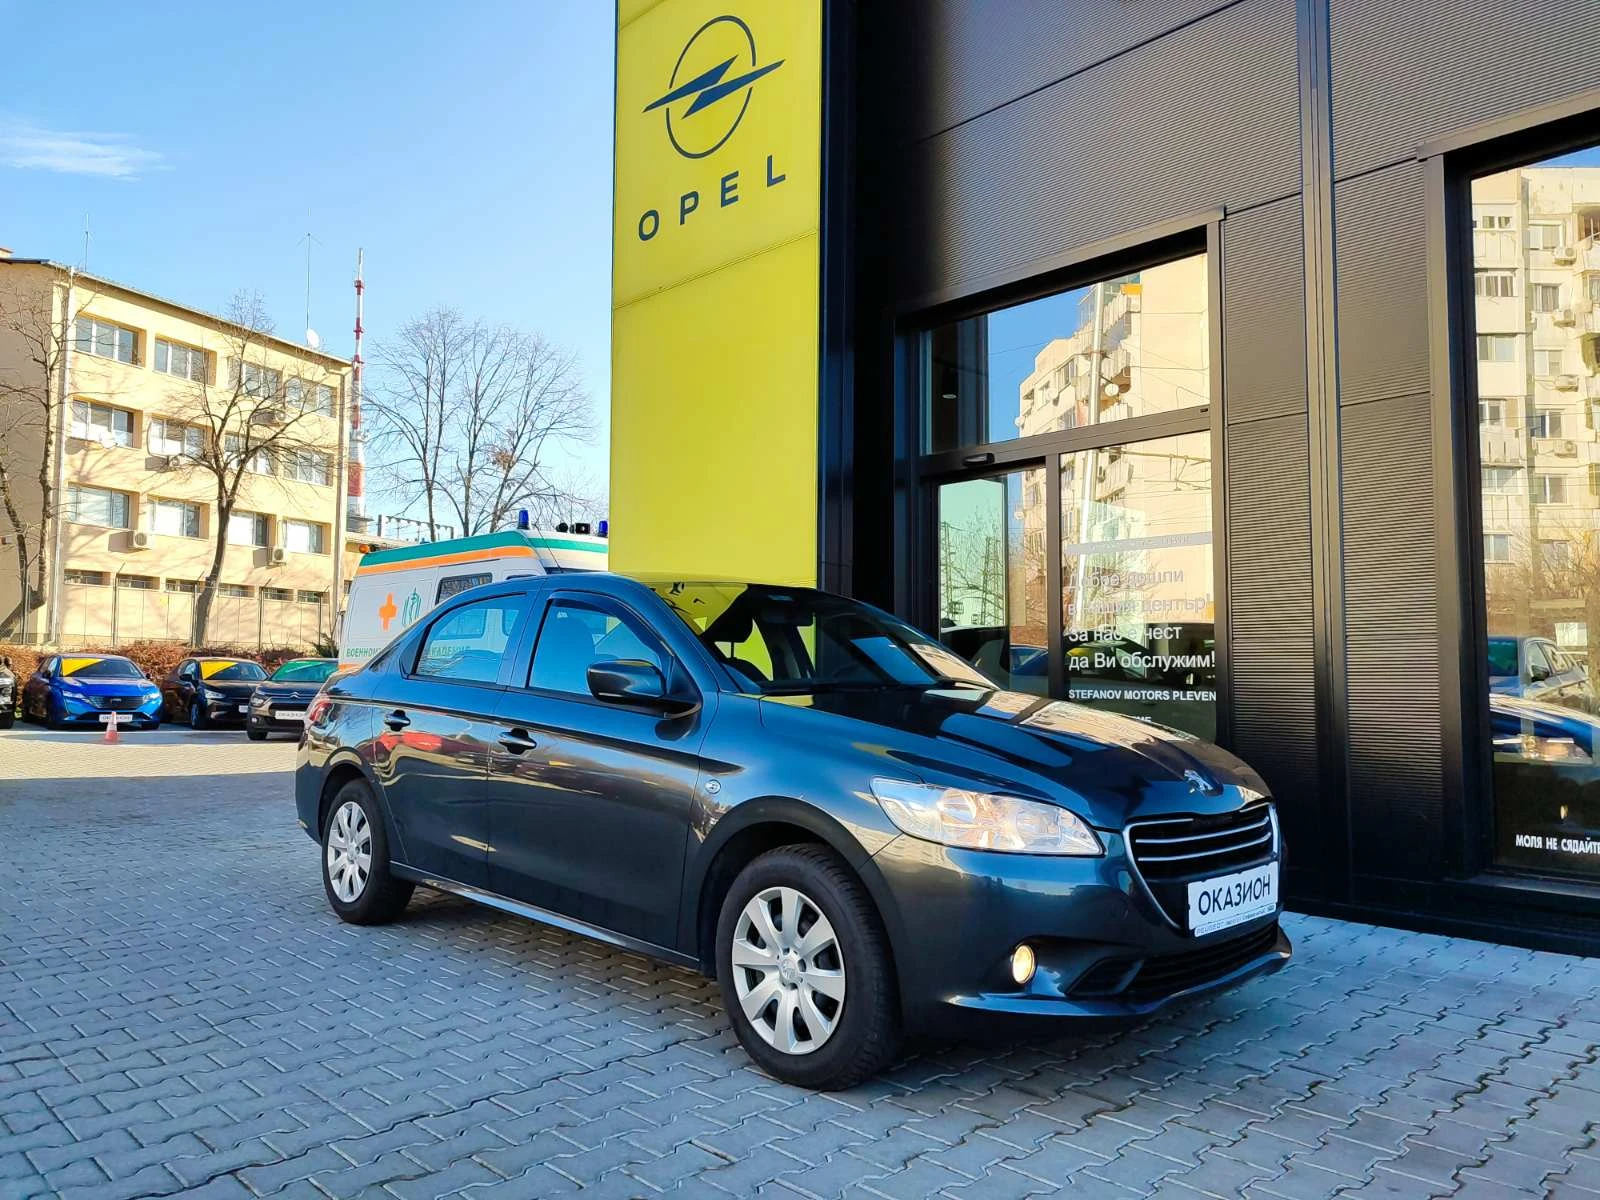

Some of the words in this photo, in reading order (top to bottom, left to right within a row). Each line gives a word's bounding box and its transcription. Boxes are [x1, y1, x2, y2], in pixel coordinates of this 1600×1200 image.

[638, 154, 786, 241] OPEL
[1068, 655, 1089, 671] да
[1094, 652, 1116, 668] Ви
[1121, 651, 1216, 672] обслужим!
[1068, 689, 1122, 700] STEFANOV
[1124, 690, 1170, 701] MOTORS
[1172, 690, 1216, 701] PLEVEN
[1515, 834, 1542, 848] МОЛЯ
[1546, 837, 1558, 850] НЕ
[1198, 873, 1271, 916] ОКАЗИОН
